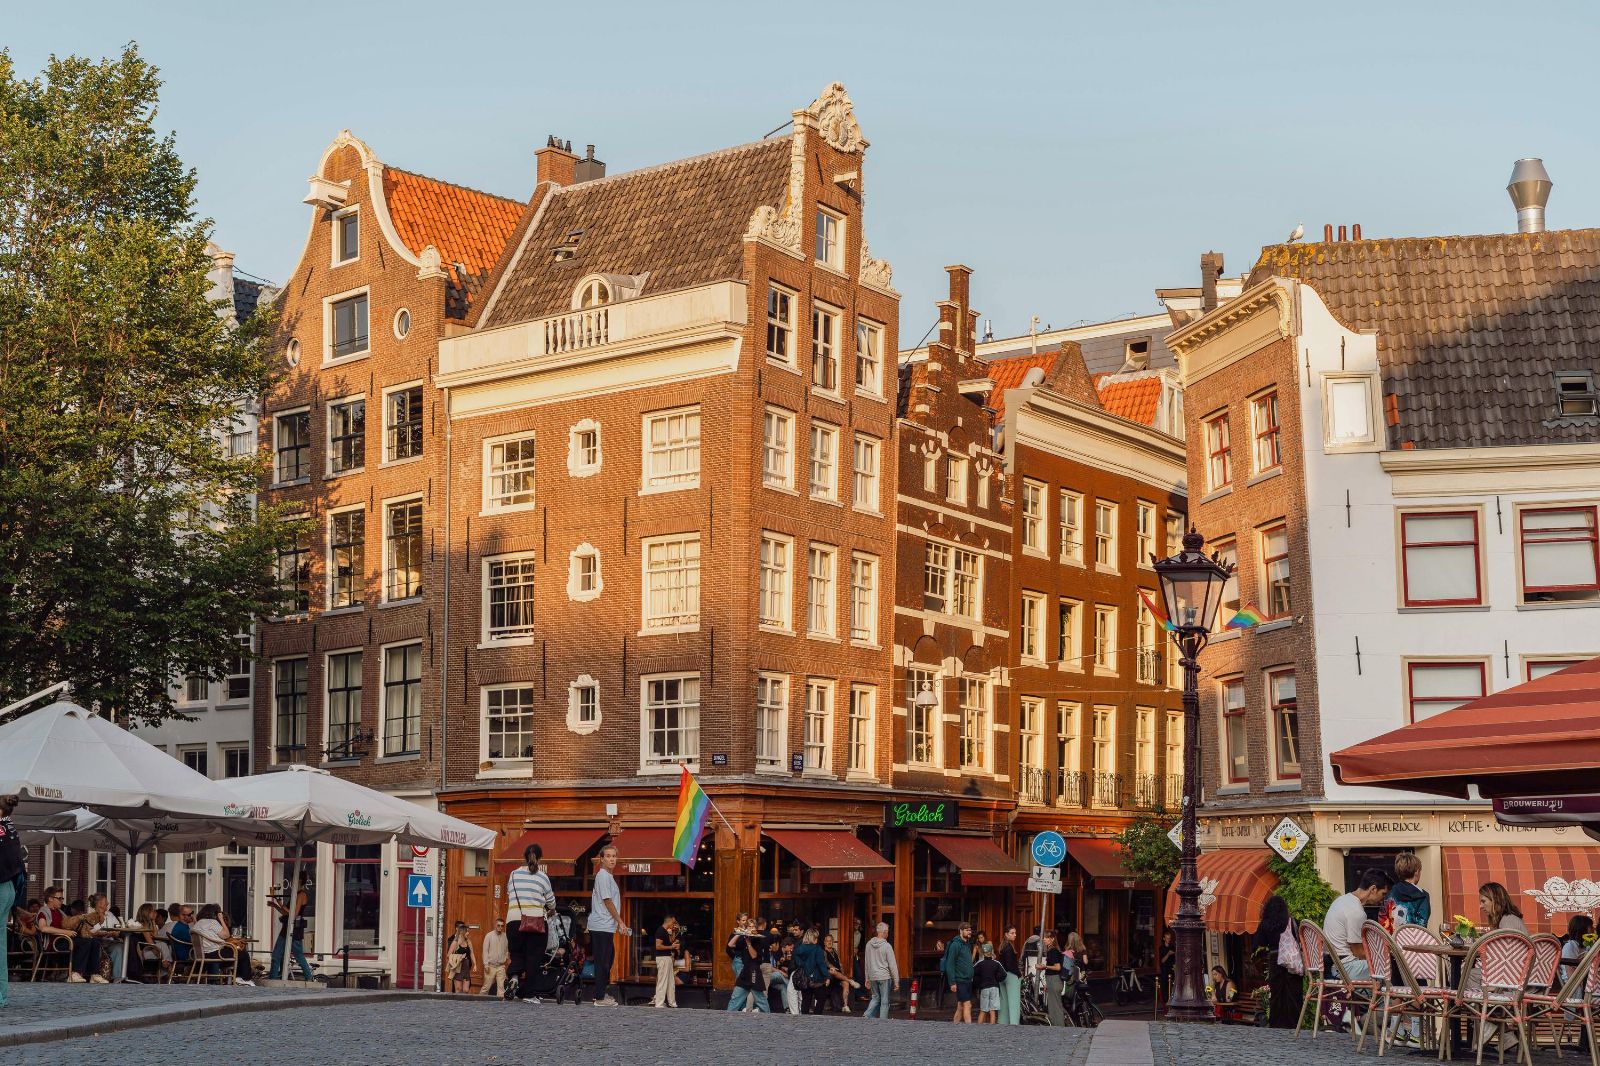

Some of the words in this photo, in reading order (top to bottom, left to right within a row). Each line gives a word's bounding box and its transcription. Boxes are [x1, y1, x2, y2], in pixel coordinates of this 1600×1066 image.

[1503, 800, 1549, 810] BROUWERIJ
[347, 813, 372, 826] Grolsch
[893, 803, 945, 826] Grolsch
[1333, 823, 1356, 833] PETIT
[1448, 820, 1484, 832] KOFFIE
